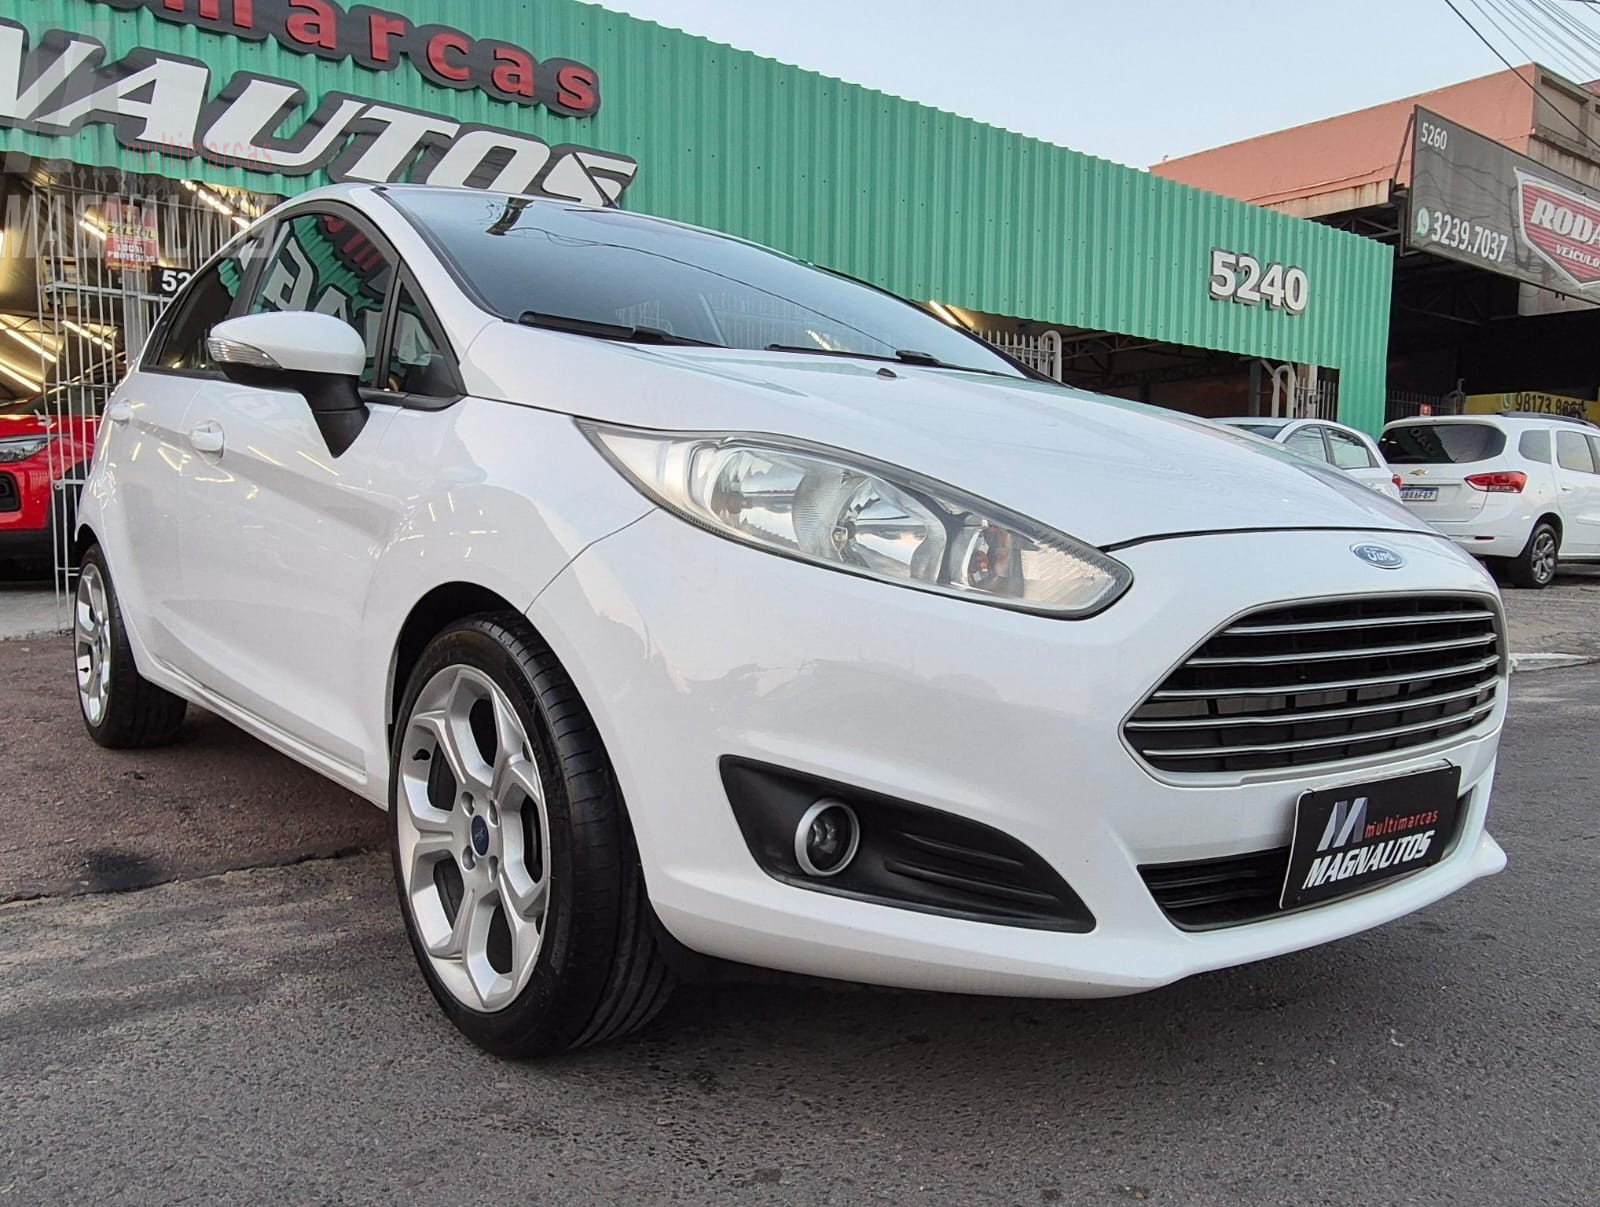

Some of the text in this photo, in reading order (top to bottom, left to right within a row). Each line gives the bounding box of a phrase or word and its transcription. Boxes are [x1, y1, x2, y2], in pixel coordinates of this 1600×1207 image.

[1421, 122, 1448, 150] 5260
[1431, 211, 1509, 262] 3239.7037
[1210, 248, 1309, 313] 5240
[1364, 809, 1439, 839] multimarcas
[1301, 829, 1436, 890] MAGNAUTOS
